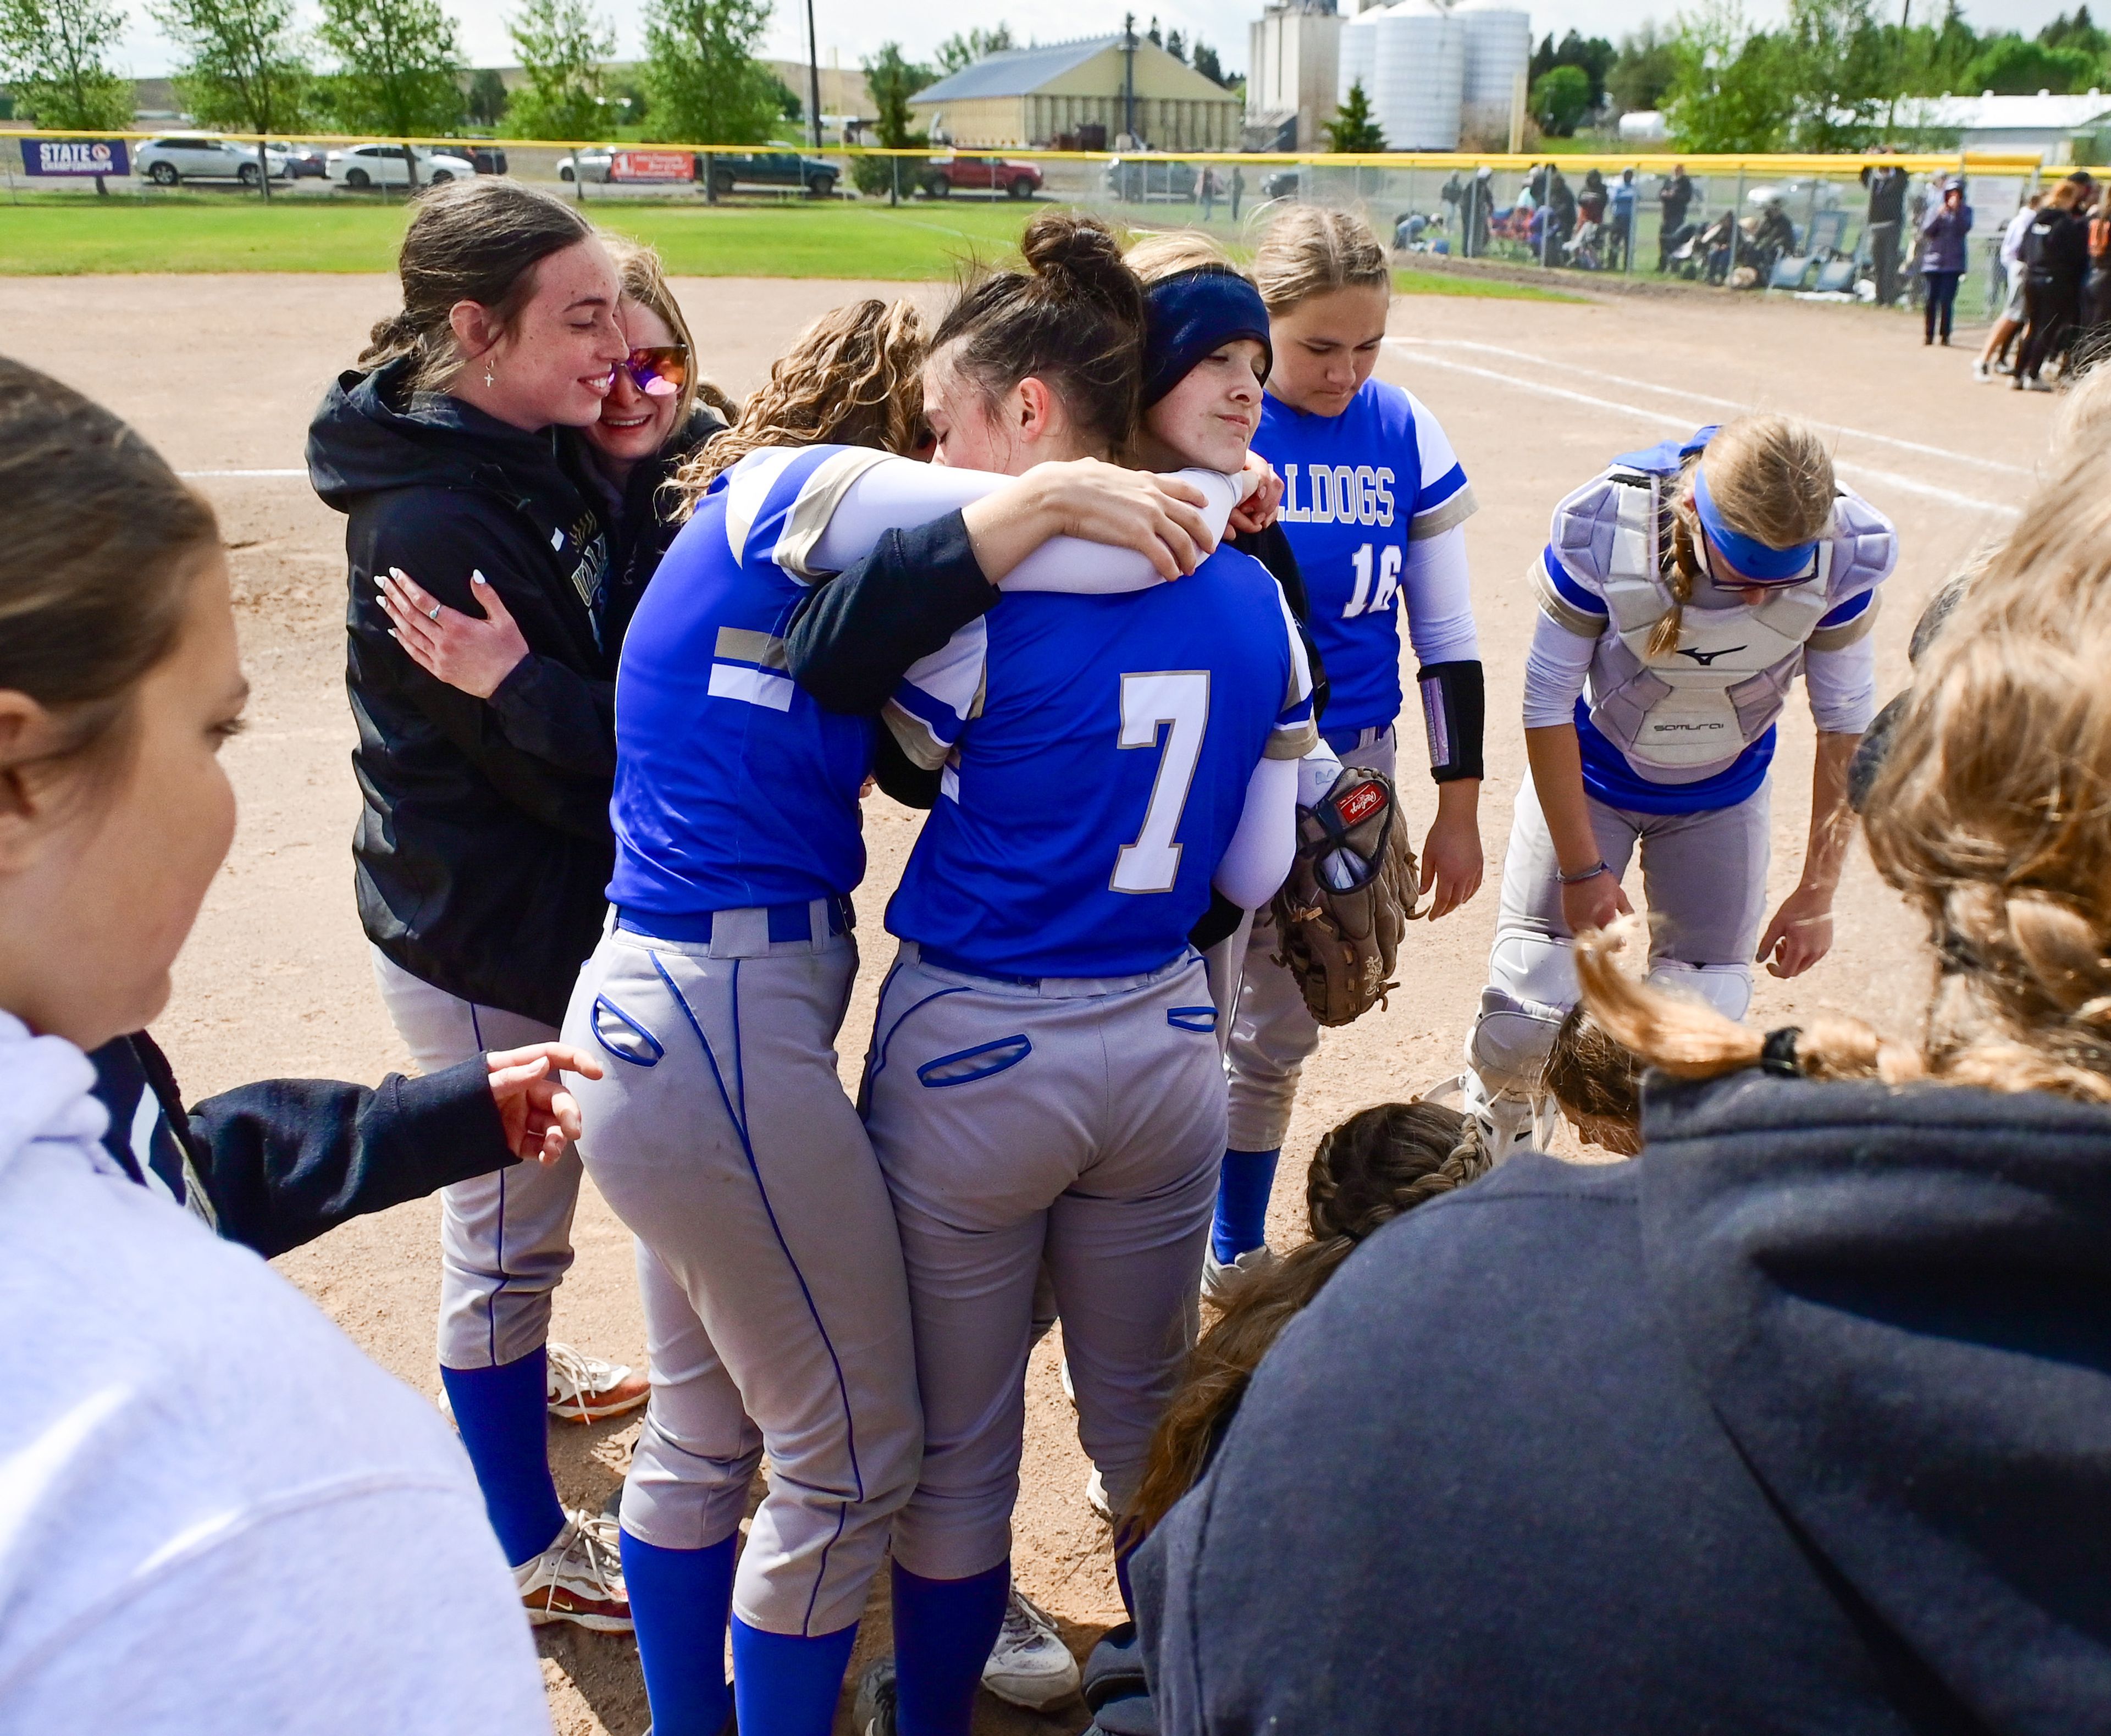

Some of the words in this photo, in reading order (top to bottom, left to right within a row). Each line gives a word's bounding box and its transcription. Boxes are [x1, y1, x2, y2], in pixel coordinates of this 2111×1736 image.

[40, 143, 91, 161] STATE
[1267, 463, 1395, 527] LDOGS
[1341, 543, 1402, 619] 16
[1109, 669, 1211, 895] 7
